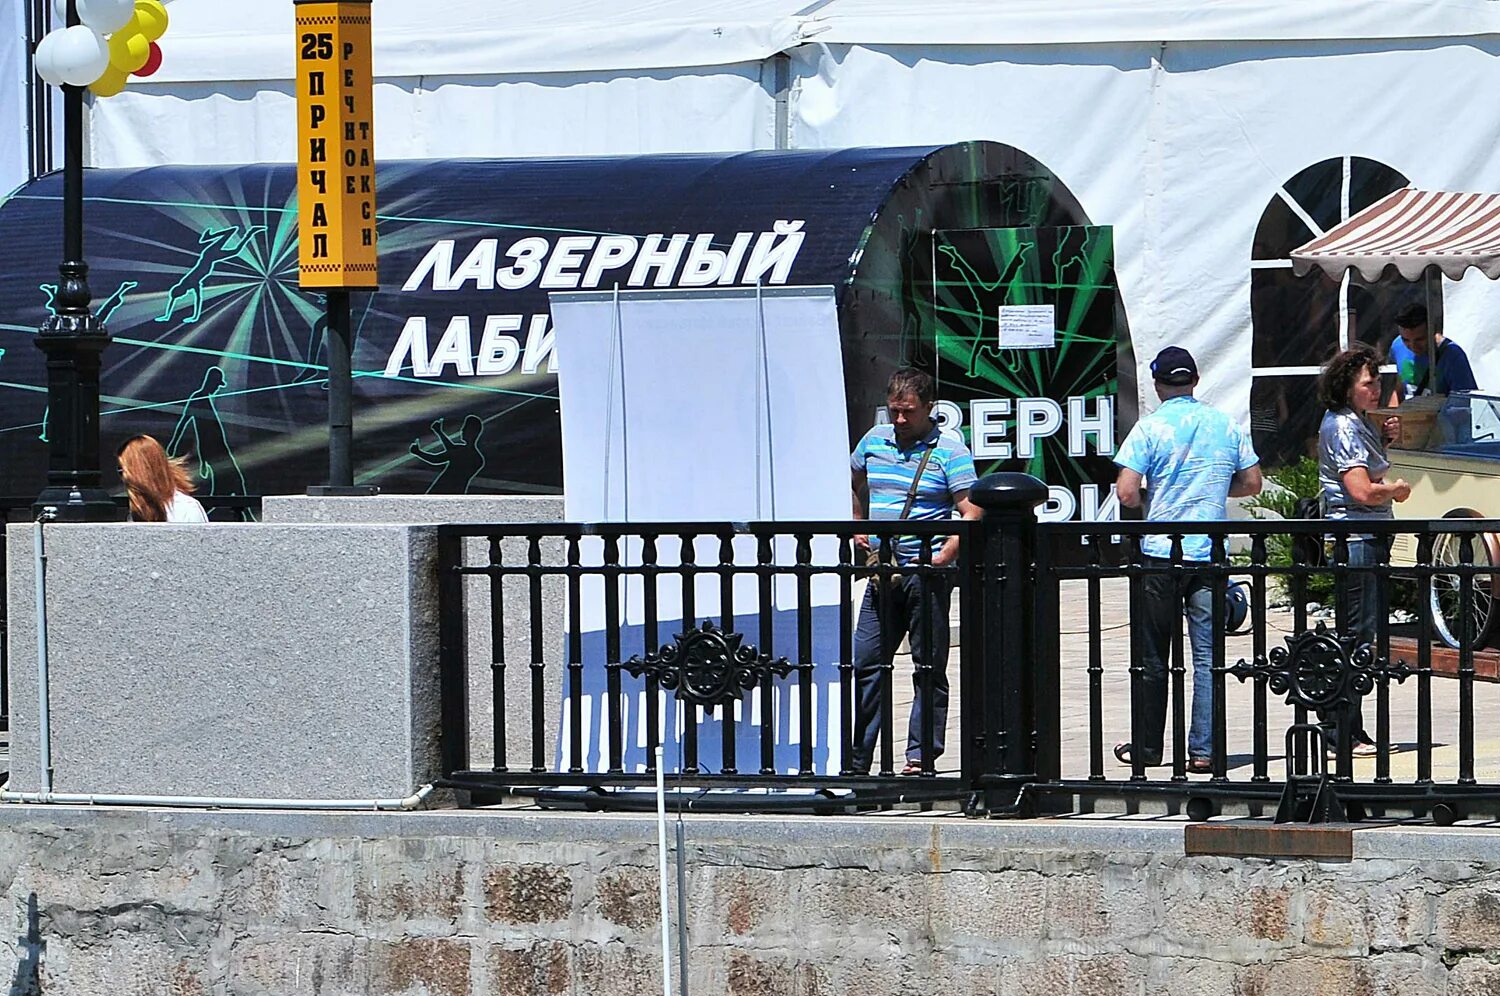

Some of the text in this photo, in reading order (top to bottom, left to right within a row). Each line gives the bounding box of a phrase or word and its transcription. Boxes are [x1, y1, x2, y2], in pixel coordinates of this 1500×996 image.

[301, 33, 333, 259] 25 ПРИЧАЛ
[343, 42, 356, 194] РЕЧНОЕ
[402, 219, 807, 292] ЛАЗЕРНЫЙ
